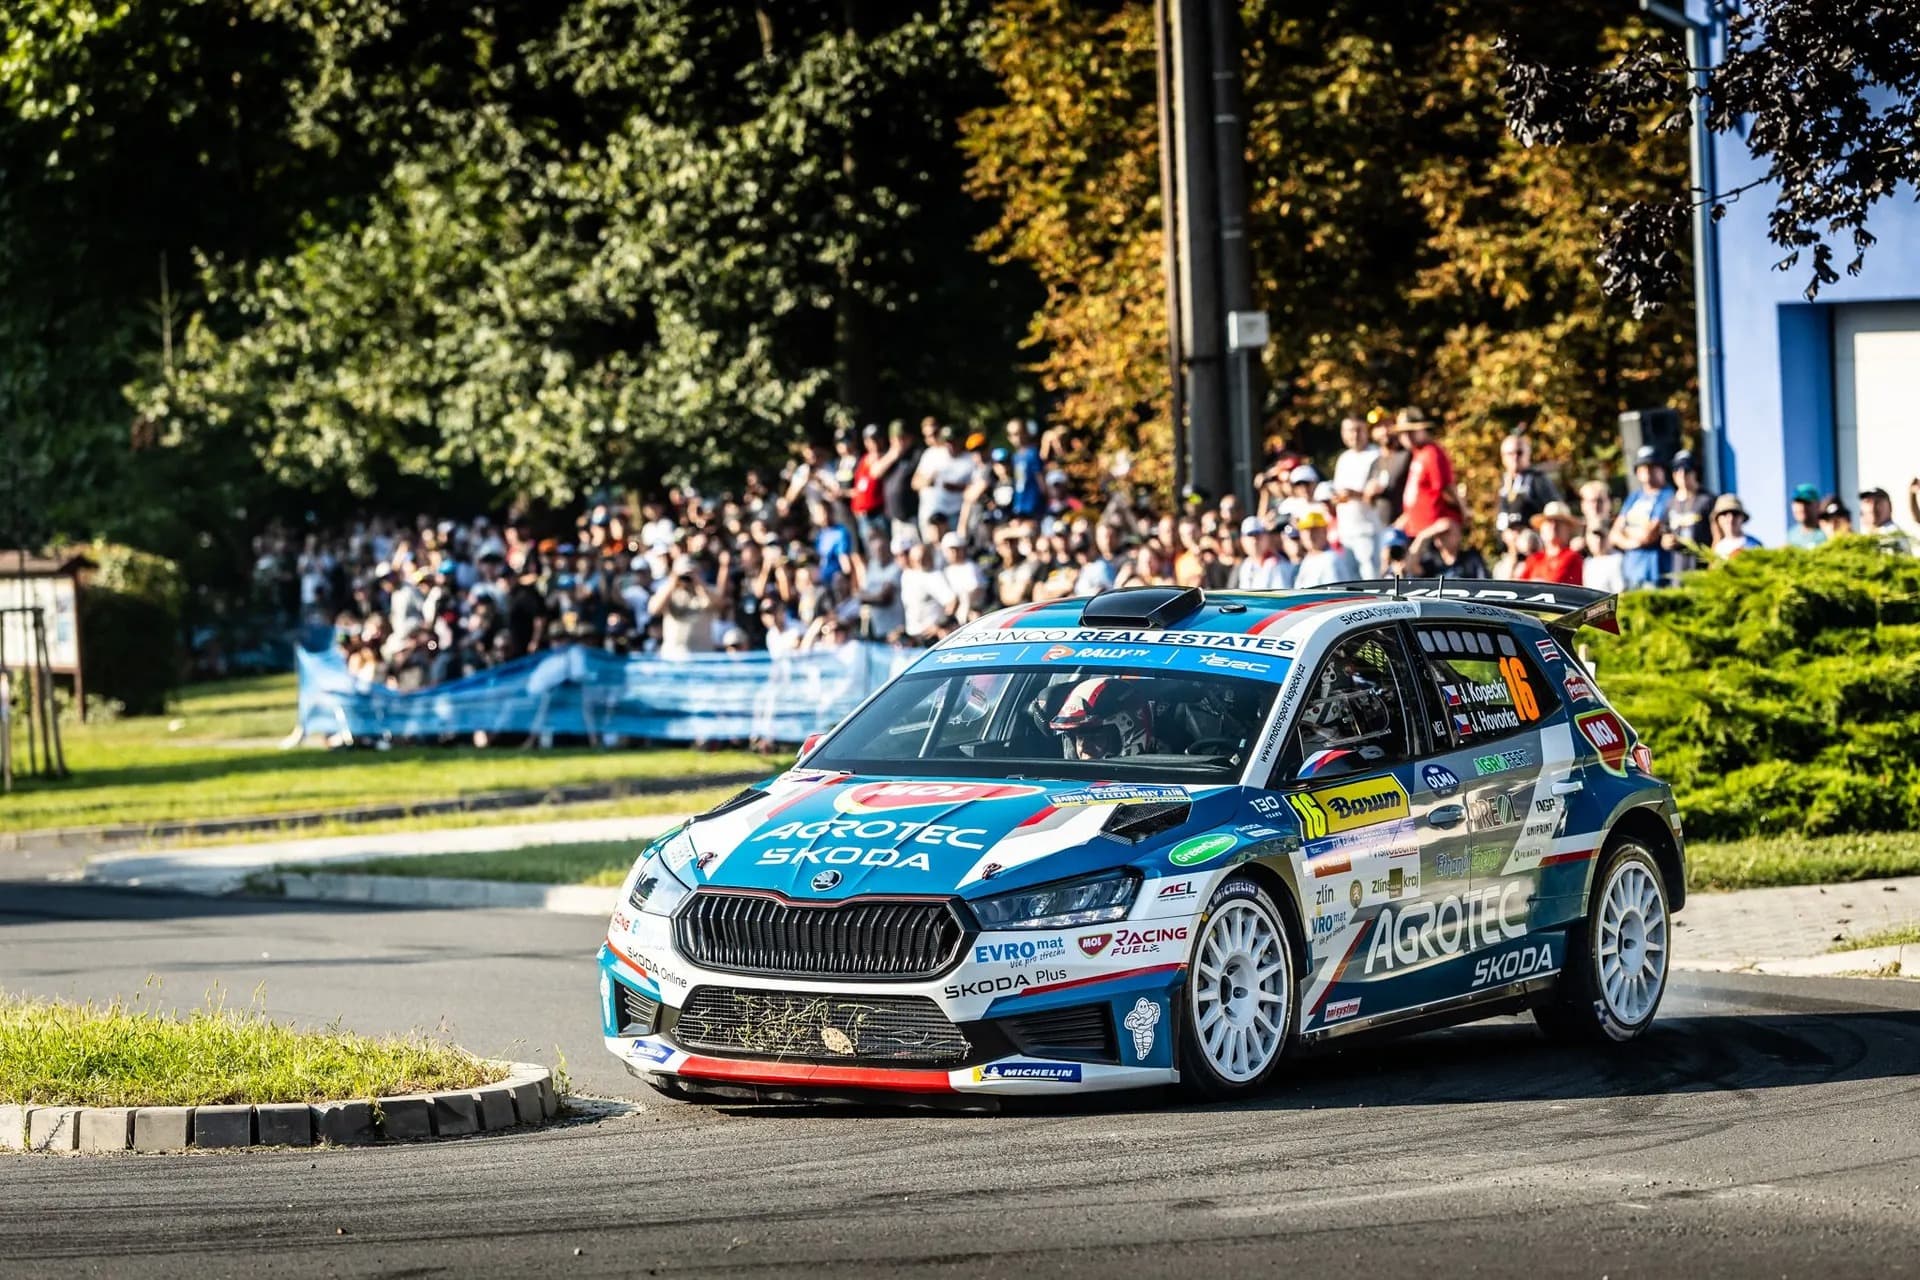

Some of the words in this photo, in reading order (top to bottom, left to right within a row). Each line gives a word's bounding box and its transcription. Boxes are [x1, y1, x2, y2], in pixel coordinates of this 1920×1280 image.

[954, 630, 1067, 642] FRANCO
[1072, 631, 1149, 643] REAL
[1158, 632, 1296, 651] ESTATES
[1206, 655, 1271, 672] ERC
[1460, 682, 1471, 704] J.
[1467, 676, 1510, 706] Kopecký
[1499, 656, 1540, 721] 16
[1471, 711, 1481, 733] J.
[1477, 707, 1520, 732] Hovorka
[1426, 771, 1458, 789] OLMA
[1248, 796, 1280, 814] 130
[1290, 791, 1329, 841] 16
[1327, 790, 1402, 819] Barum
[751, 819, 988, 850] AGROTEC
[1160, 881, 1198, 895] ACL
[1403, 871, 1419, 888] kraj
[1315, 884, 1334, 906] zlín
[1115, 926, 1188, 946] RACING
[1363, 880, 1528, 975] AGROTEC
[1082, 937, 1102, 949] MOL
[660, 967, 688, 988] Online
[1036, 968, 1067, 985] Plus
[1003, 1068, 1073, 1077] MICHELIN
